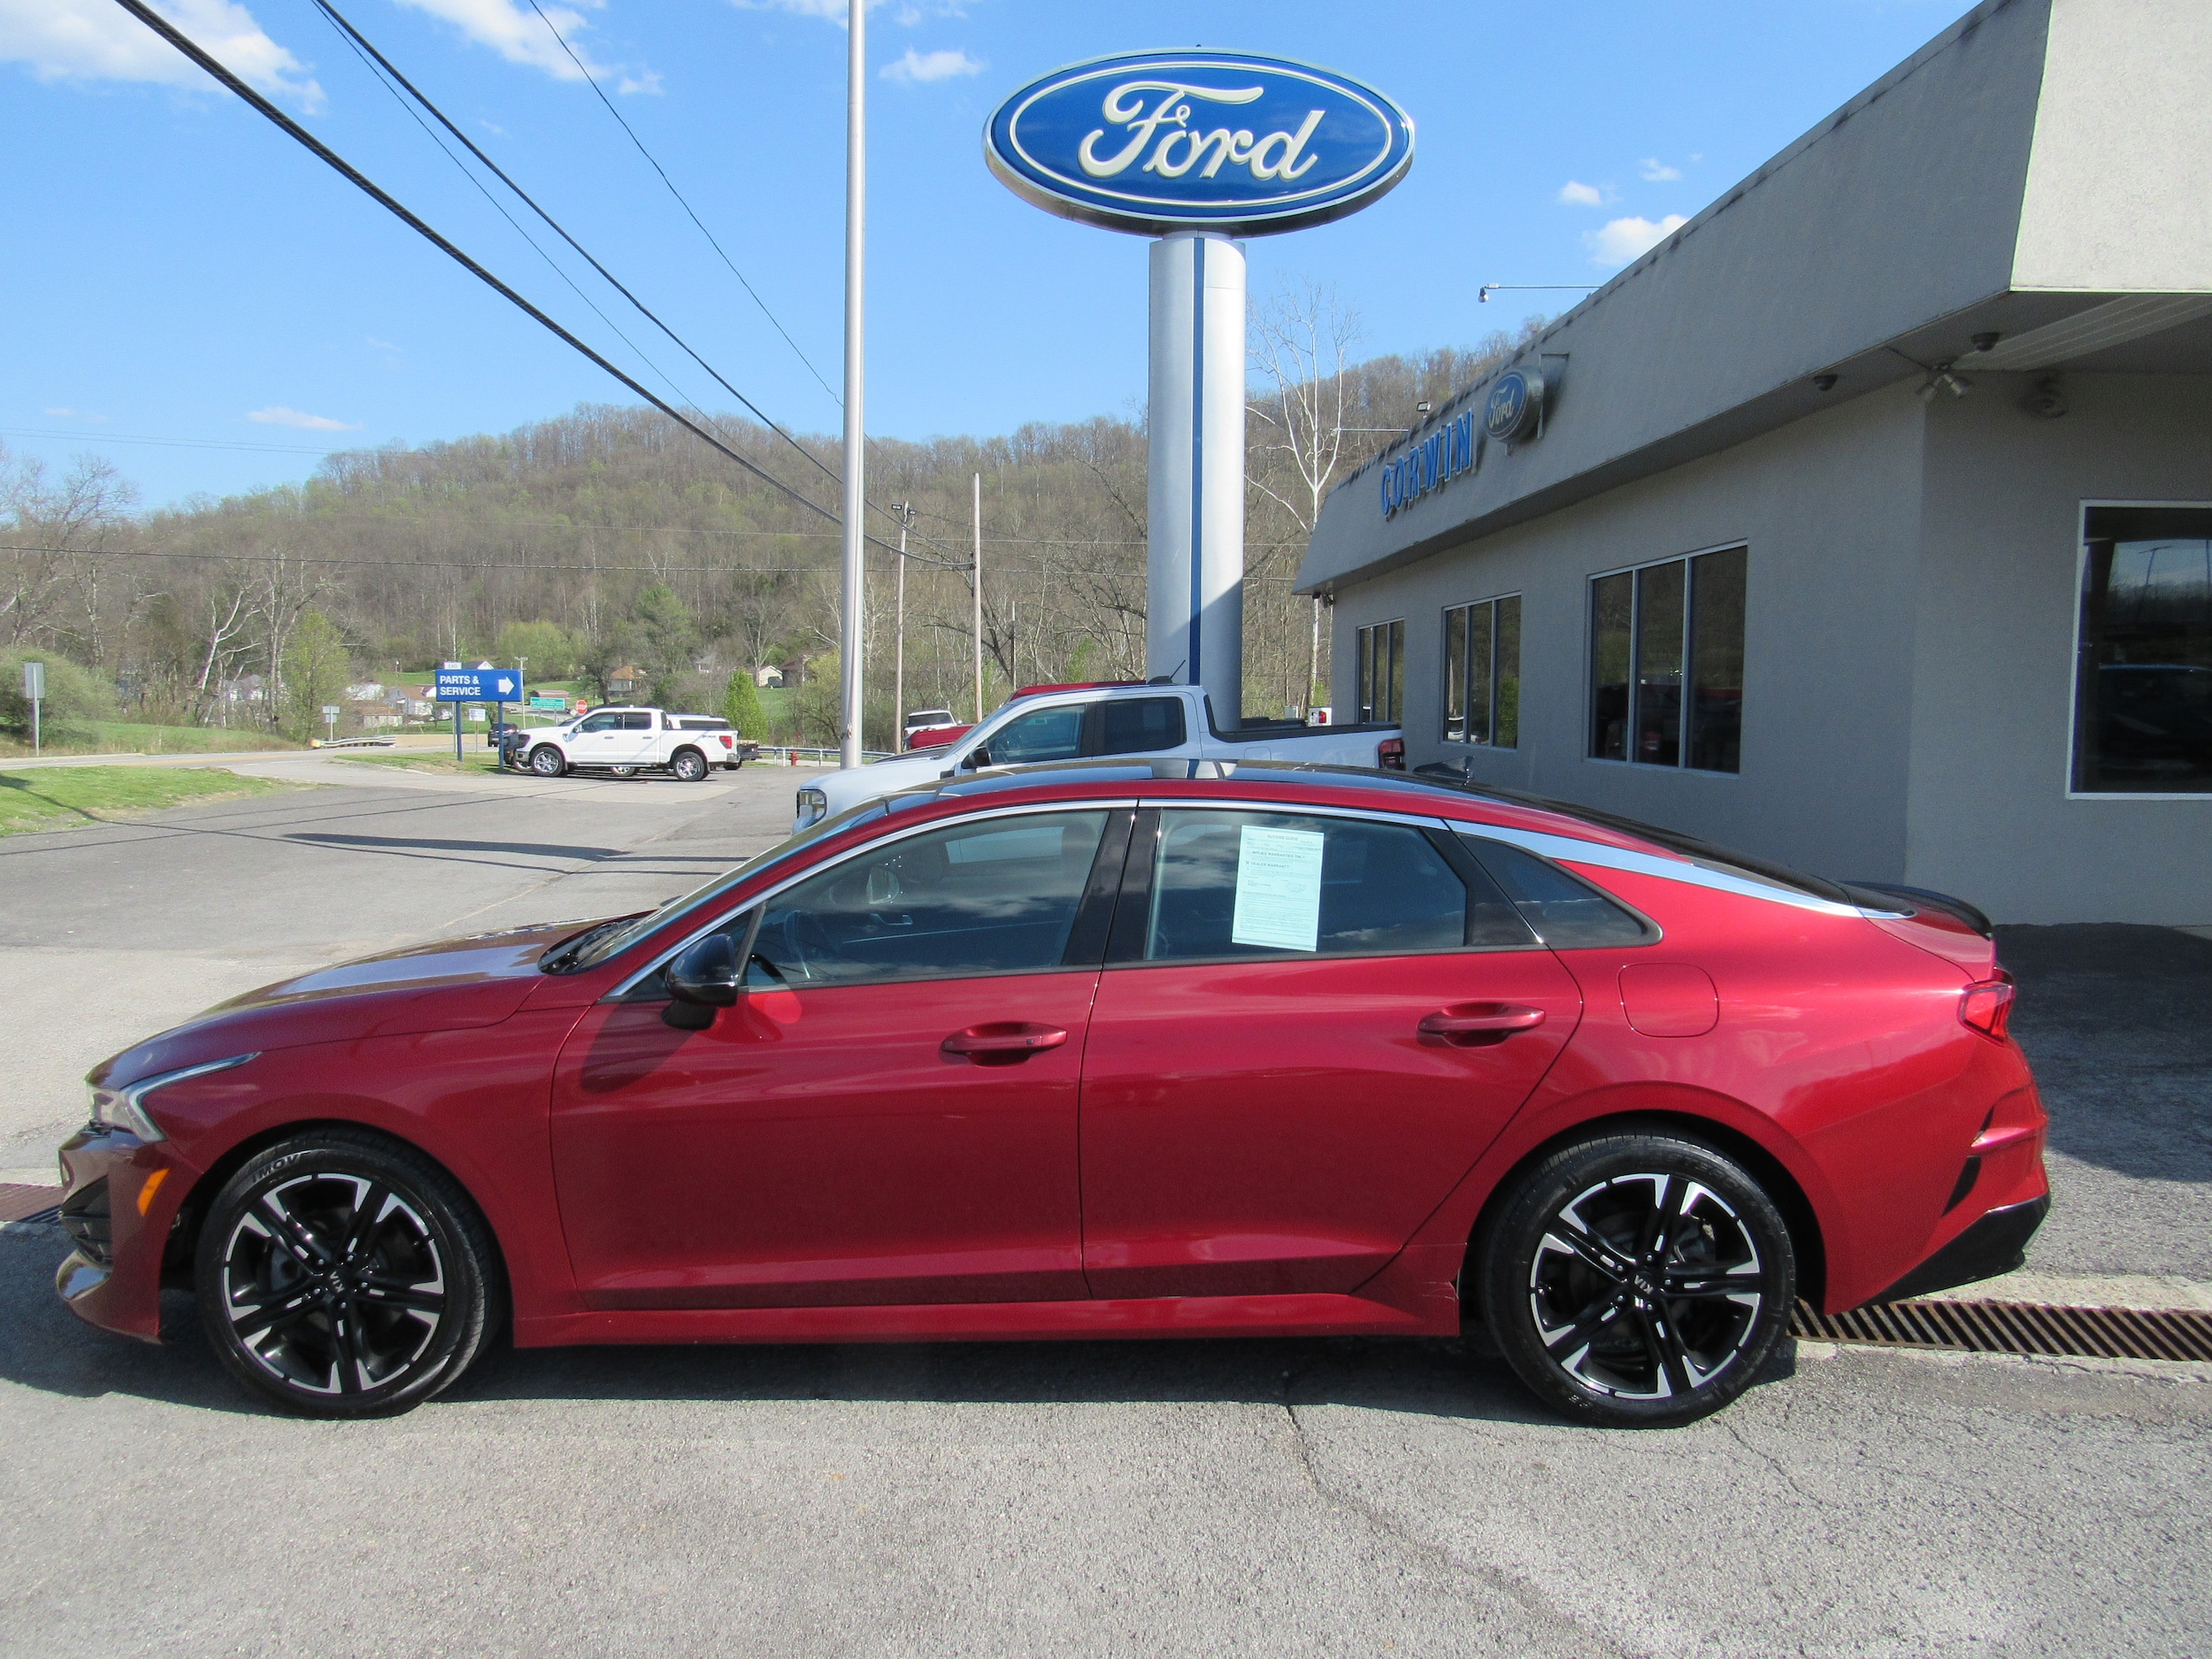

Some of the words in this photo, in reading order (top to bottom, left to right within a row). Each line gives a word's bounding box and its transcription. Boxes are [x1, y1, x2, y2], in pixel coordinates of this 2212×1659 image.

[1078, 81, 1325, 180] Ford
[1488, 385, 1515, 429] Ford
[1381, 407, 1473, 516] CORWIN
[440, 675, 471, 684] PARTS
[440, 687, 481, 695] SERVICE
[330, 1271, 344, 1293] KIA
[1633, 1275, 1654, 1294] KIA
